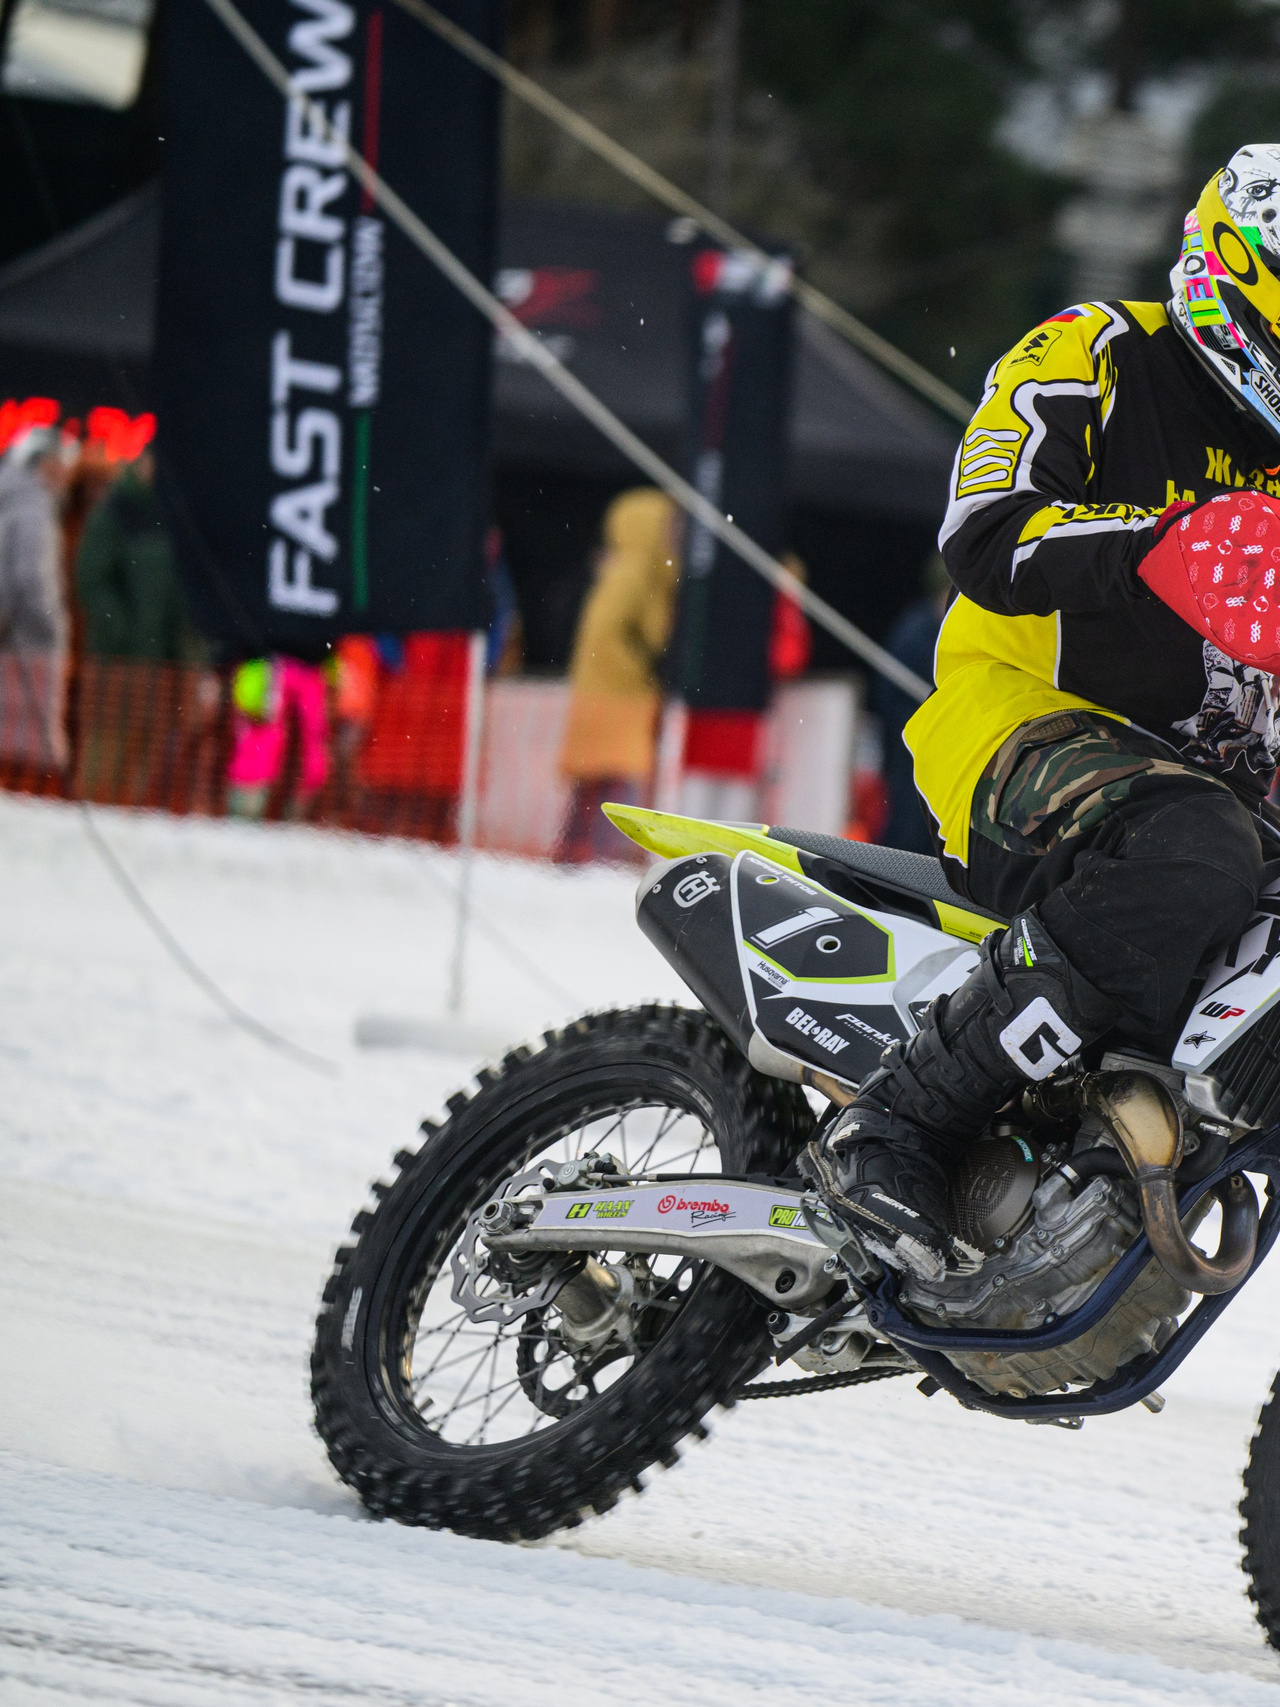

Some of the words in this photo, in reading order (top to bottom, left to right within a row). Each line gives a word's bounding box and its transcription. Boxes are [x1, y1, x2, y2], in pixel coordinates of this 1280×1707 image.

[275, 0, 359, 313] CREW
[267, 330, 346, 618] FAST
[750, 906, 844, 950] 1
[757, 961, 789, 986] Husqvarna
[676, 1198, 730, 1214] brembo
[691, 1210, 734, 1226] Racing
